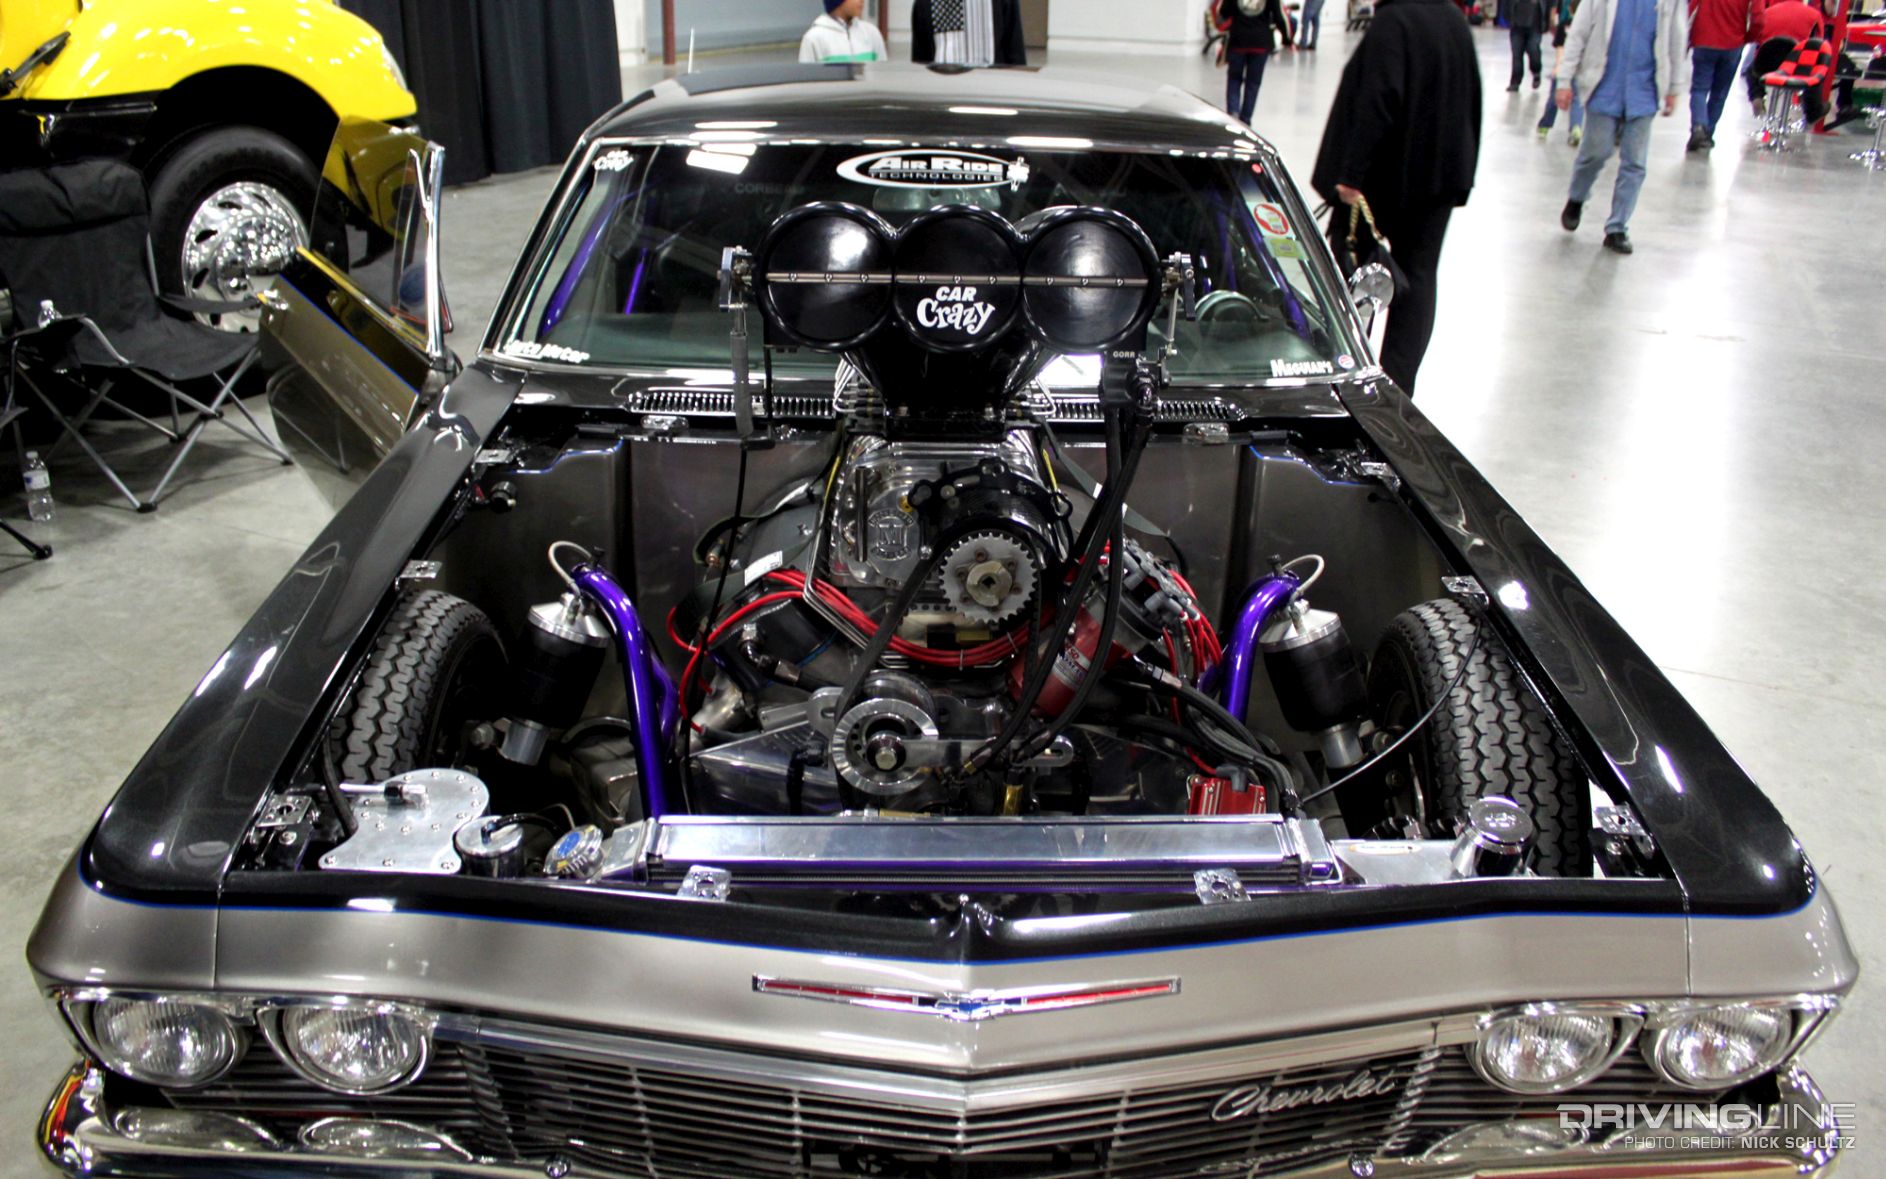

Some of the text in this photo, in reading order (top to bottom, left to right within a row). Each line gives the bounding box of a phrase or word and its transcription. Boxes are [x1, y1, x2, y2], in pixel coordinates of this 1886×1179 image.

[868, 157, 1003, 173] AIR RIDE
[870, 172, 1003, 182] TECHNOLOGIES
[935, 285, 977, 302] CAR
[916, 297, 996, 335] Crazy
[1211, 1069, 1397, 1122] Chevrolet
